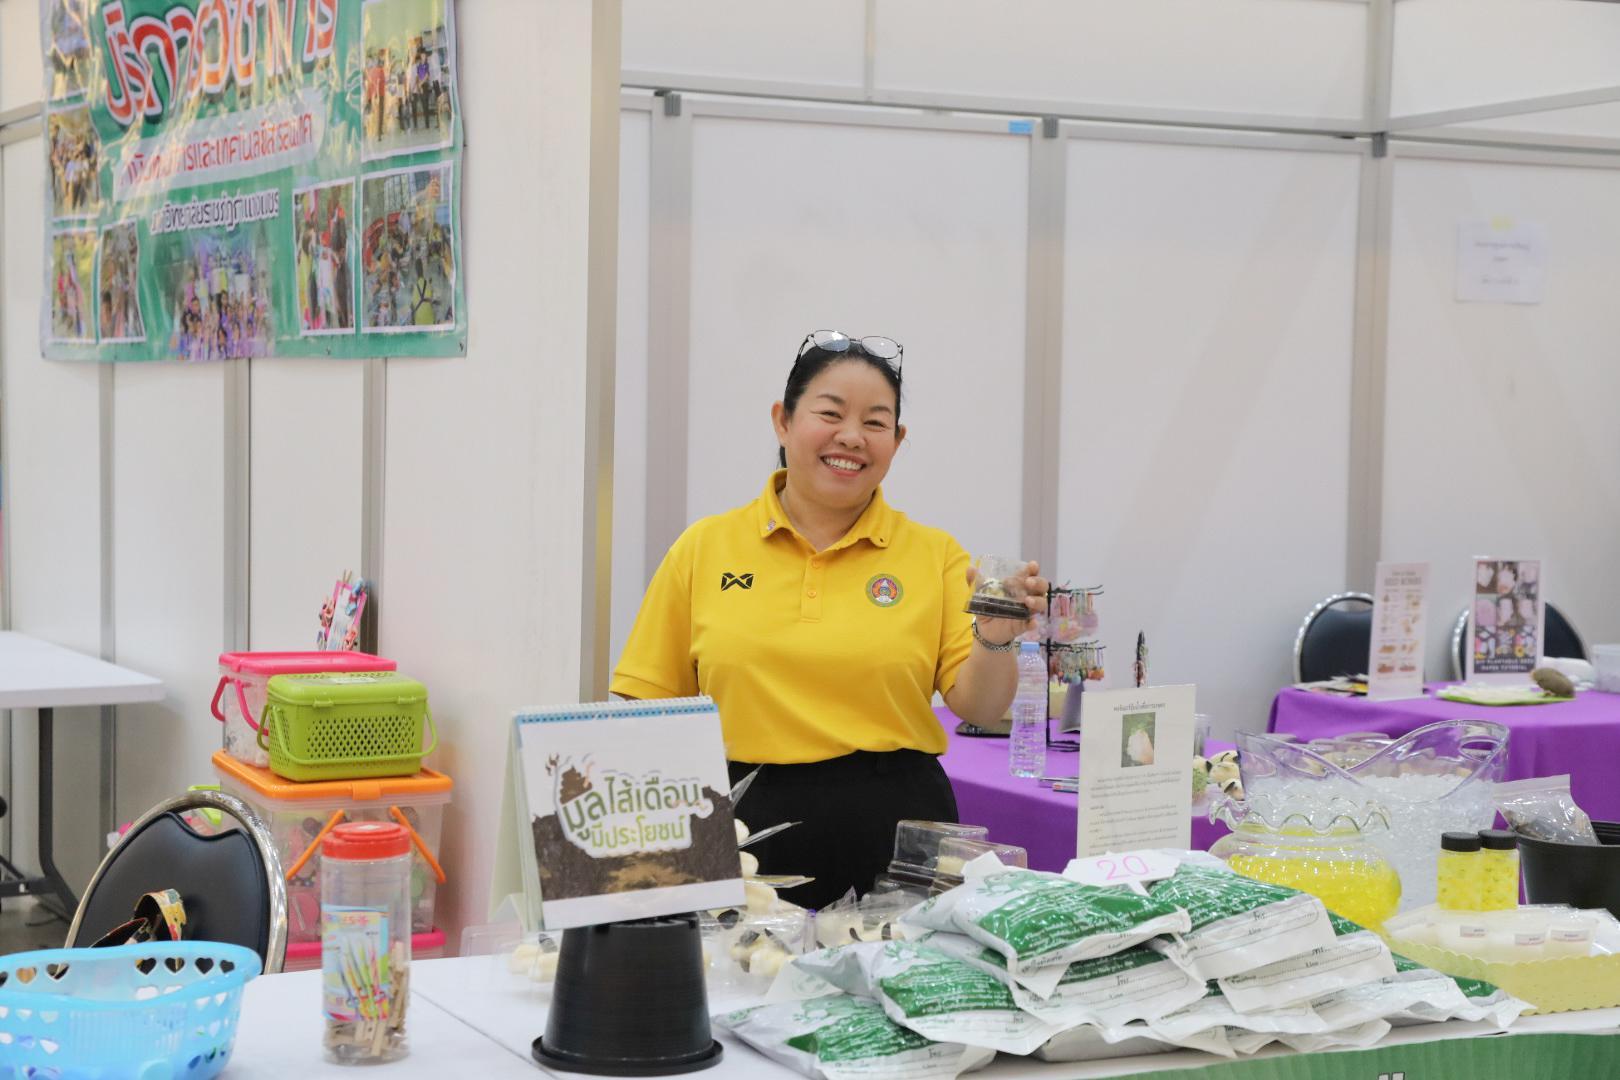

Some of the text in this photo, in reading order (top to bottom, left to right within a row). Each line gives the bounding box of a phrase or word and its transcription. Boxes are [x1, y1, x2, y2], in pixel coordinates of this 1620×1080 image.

[562, 775, 700, 841] มูลไส้เดือน
[590, 814, 686, 850] มีประโยชน์
[1096, 855, 1149, 881] 20
